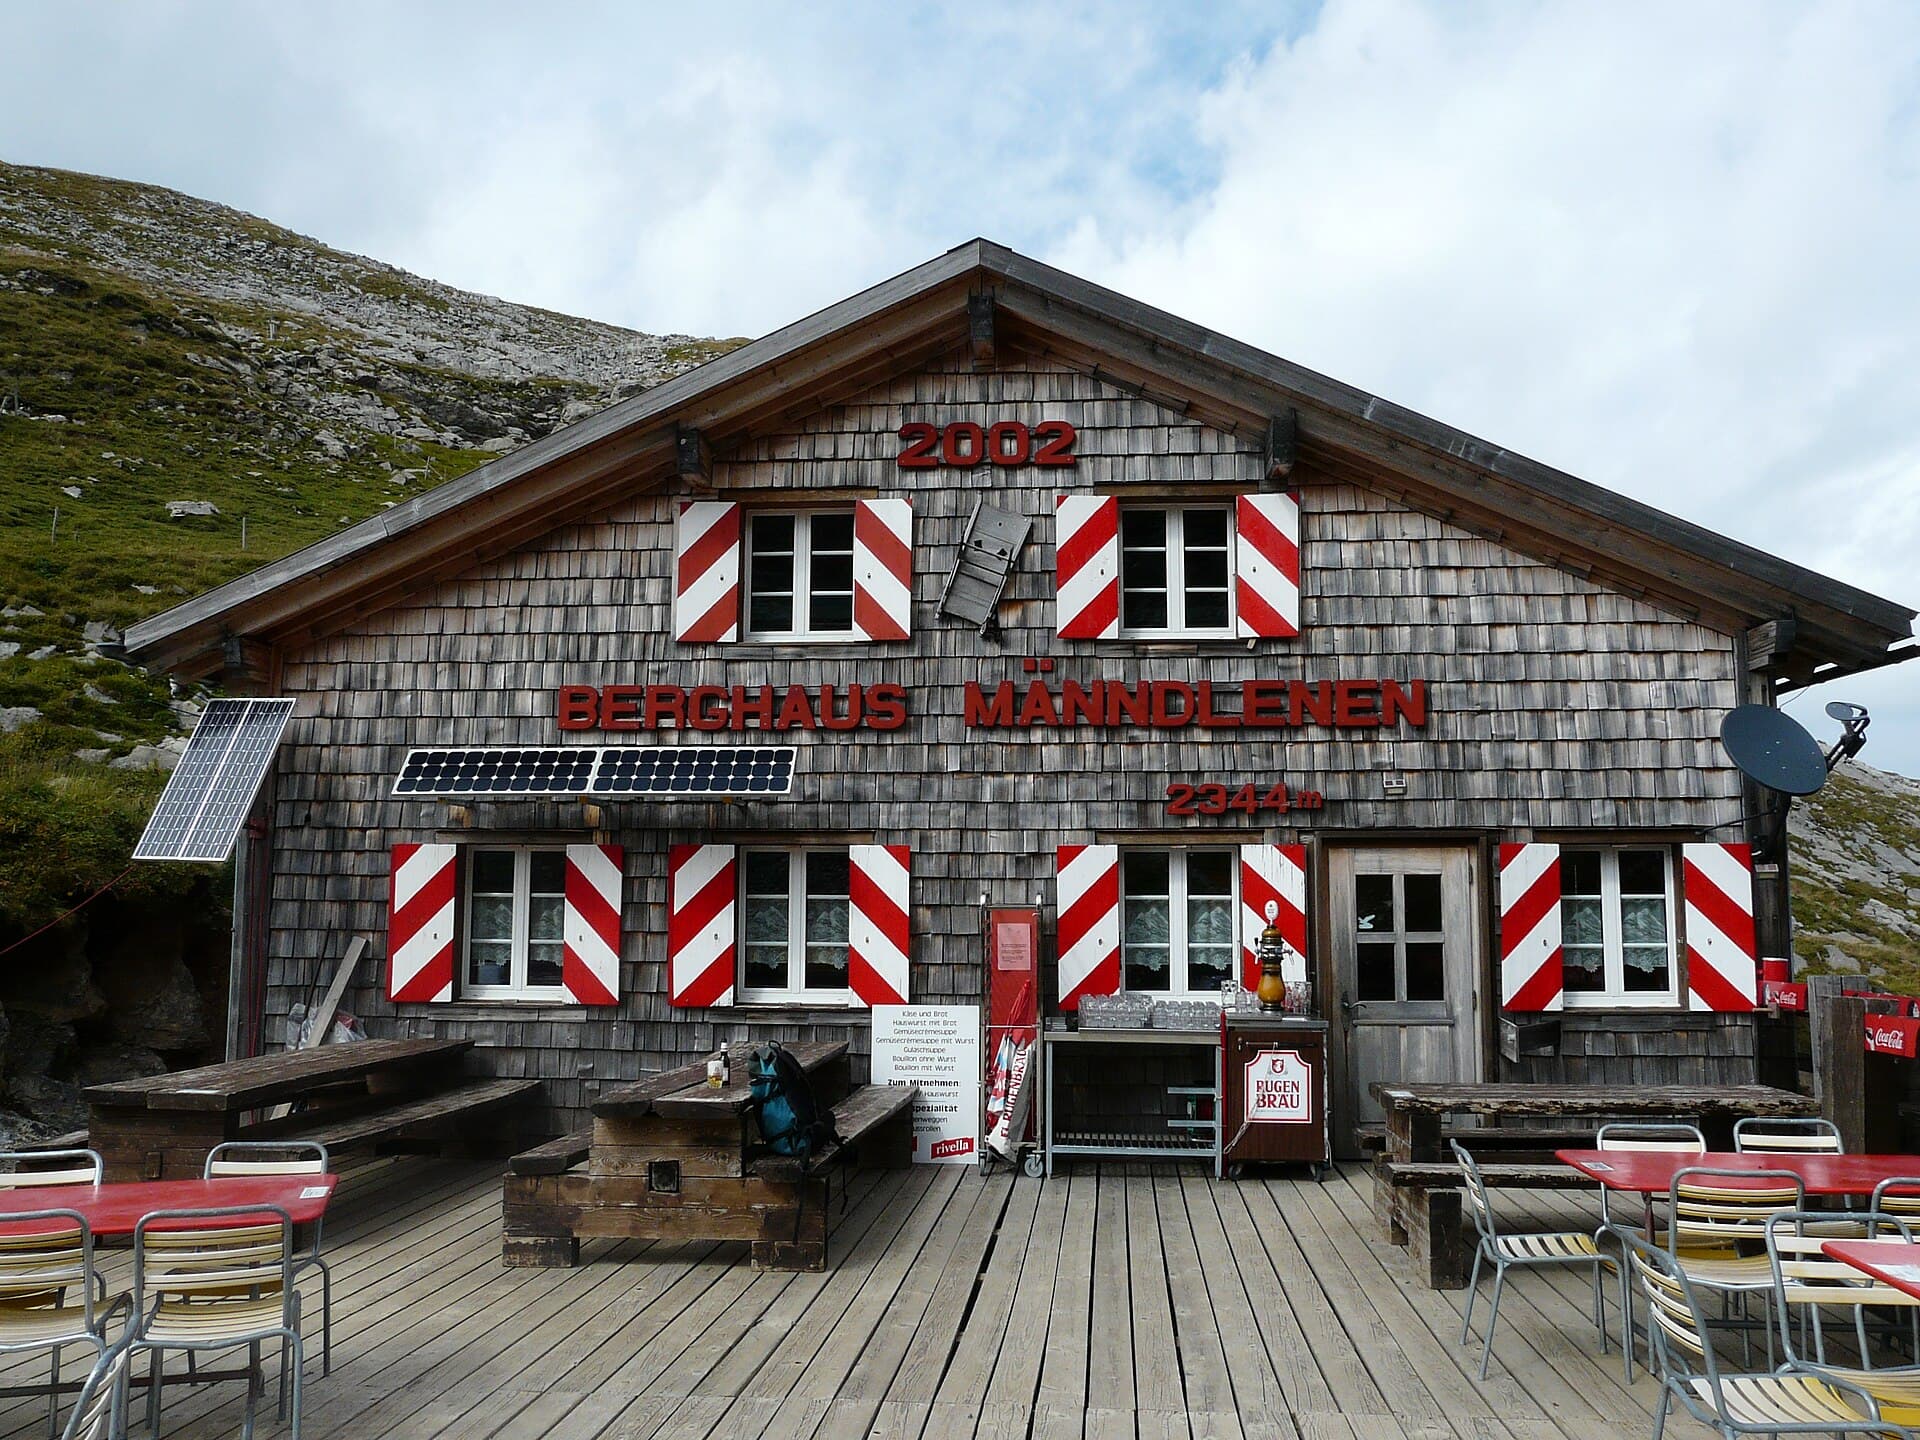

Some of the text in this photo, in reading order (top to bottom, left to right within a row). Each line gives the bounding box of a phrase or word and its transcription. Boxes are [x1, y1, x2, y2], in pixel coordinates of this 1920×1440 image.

[897, 420, 1077, 469] 2002
[557, 658, 1427, 731] BERGHAUS MÄNNDLENEN
[1165, 782, 1323, 816] 2344 m
[903, 1046, 946, 1054] Gulaschsuppe
[887, 1079, 906, 1087] Zum
[1256, 1080, 1299, 1093] RUGEN
[1256, 1093, 1299, 1109] BRÄU
[936, 1140, 969, 1155] rivella
